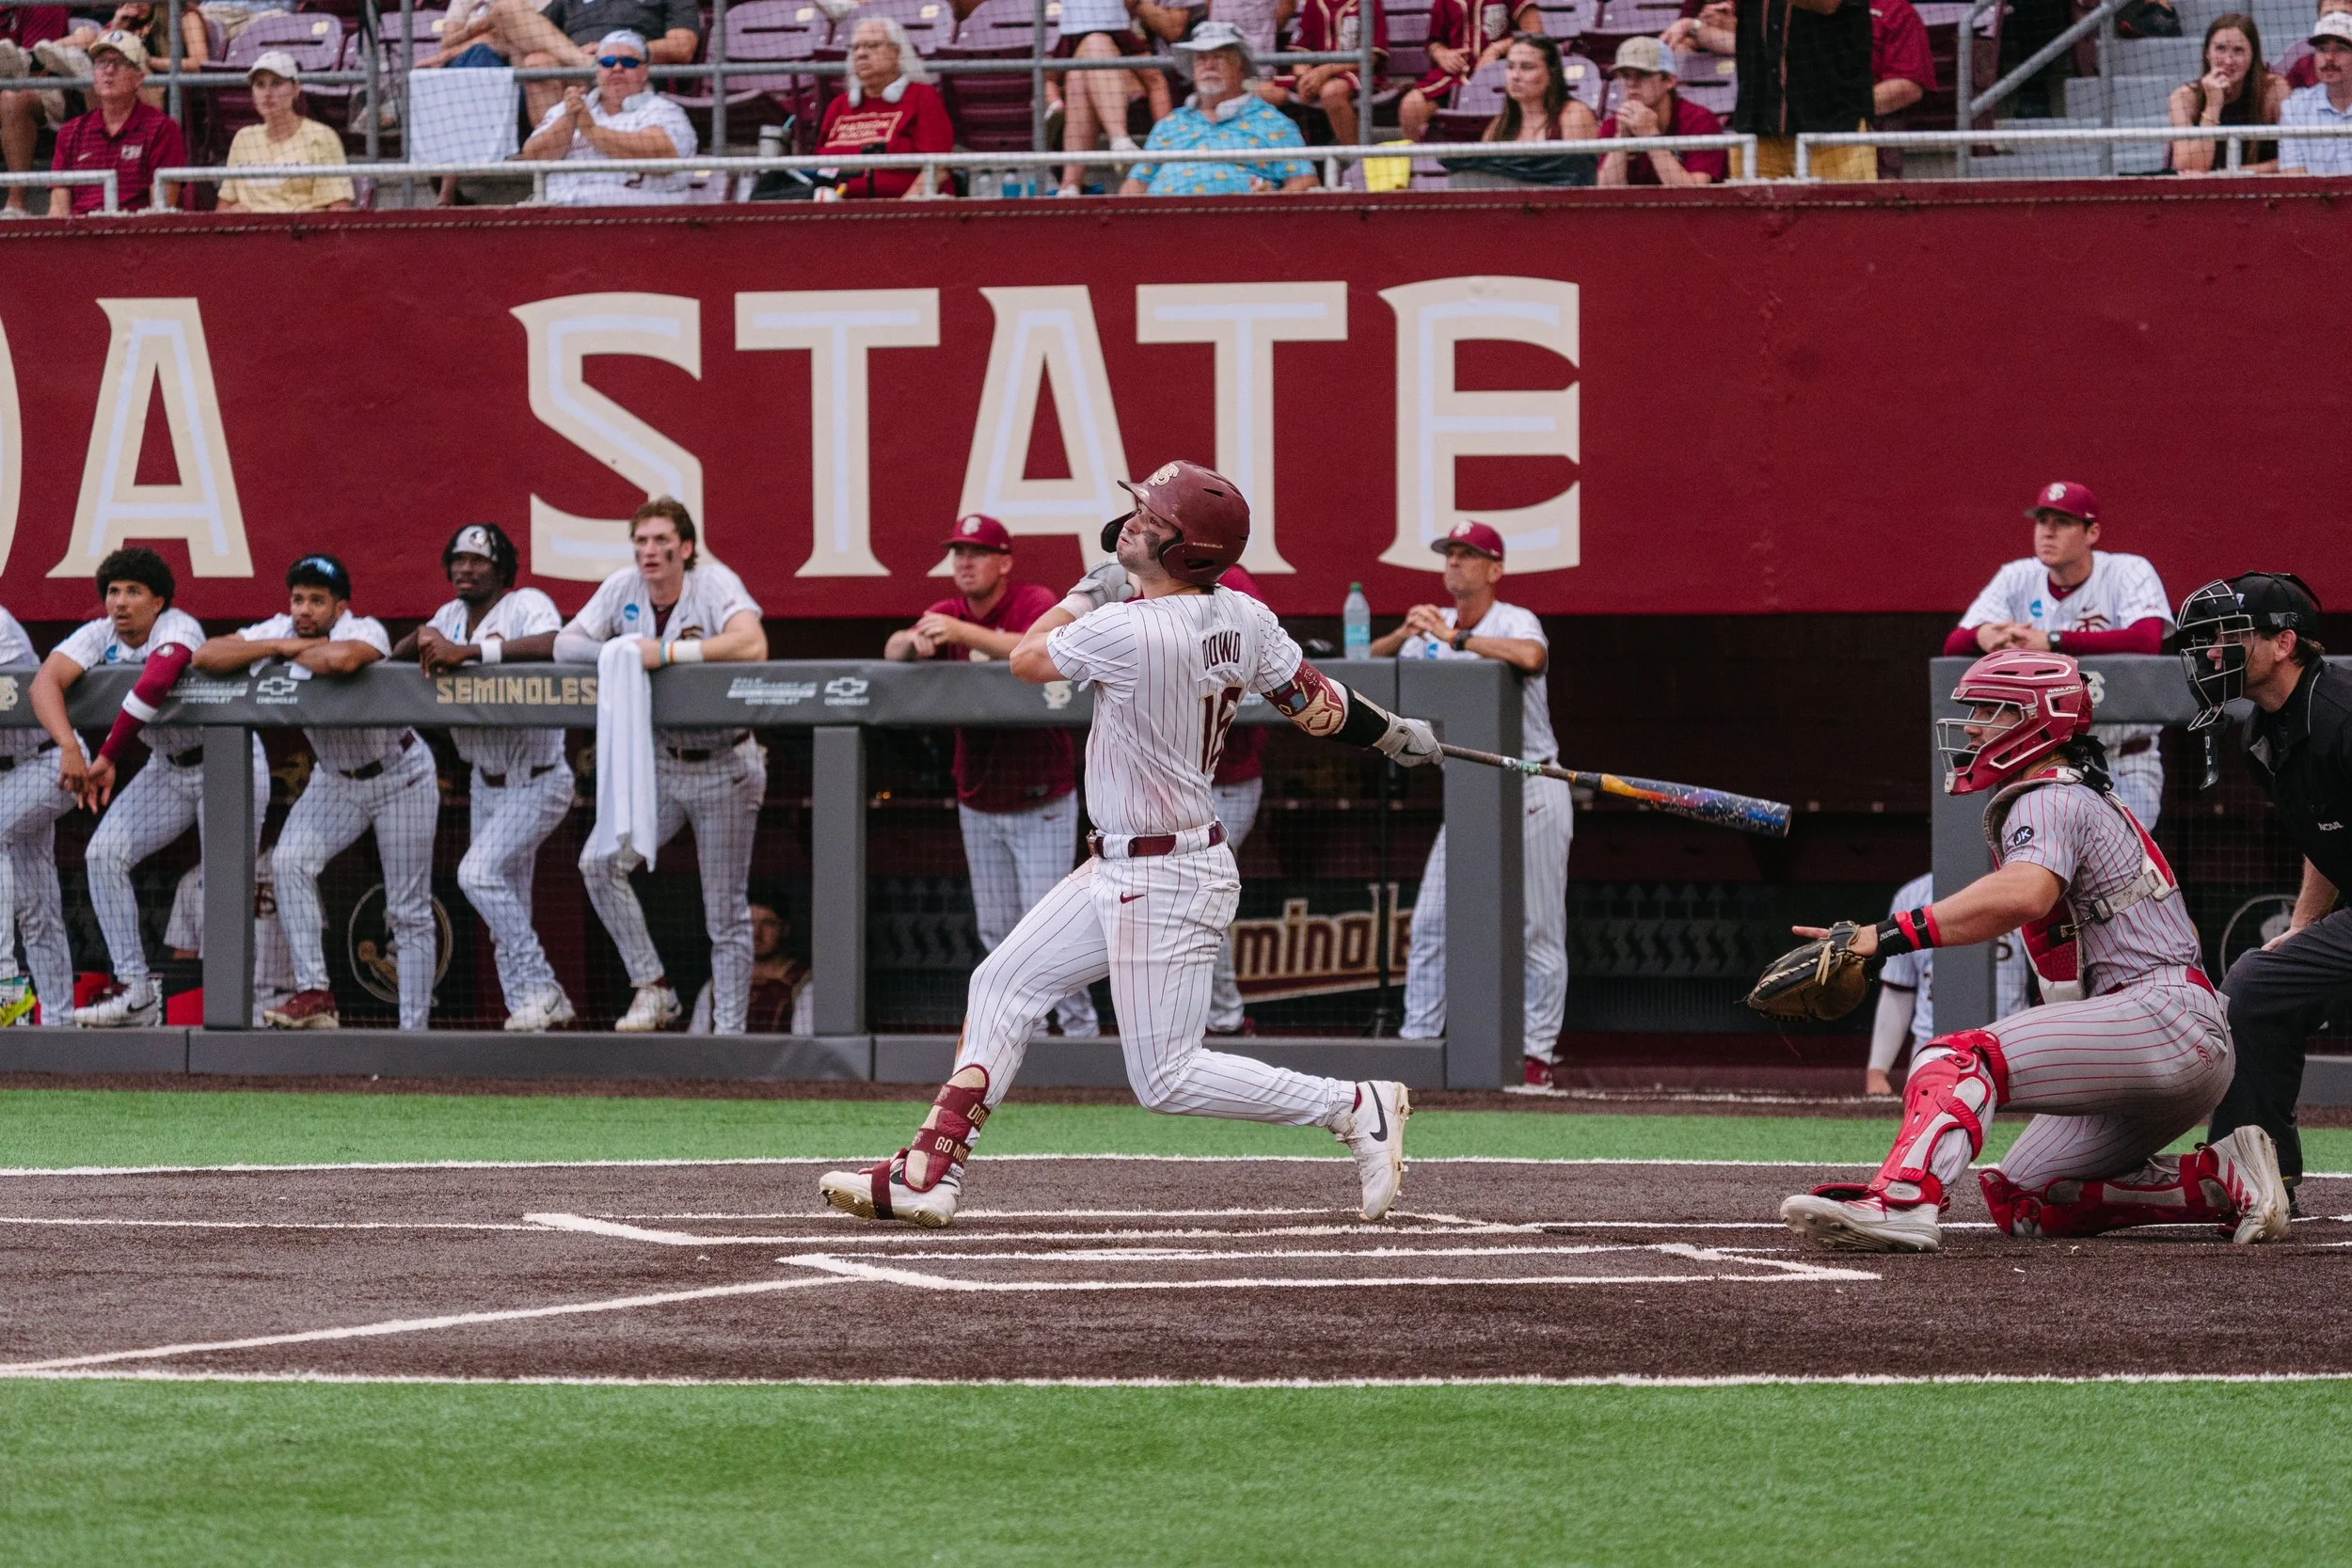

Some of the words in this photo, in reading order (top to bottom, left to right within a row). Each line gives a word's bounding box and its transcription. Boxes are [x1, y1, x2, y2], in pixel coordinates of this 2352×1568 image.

[0, 297, 255, 579] A
[509, 275, 1581, 581] STATE
[436, 676, 597, 705] SEMINOLES
[2015, 828, 2031, 845] JK
[934, 1136, 953, 1154] GO
